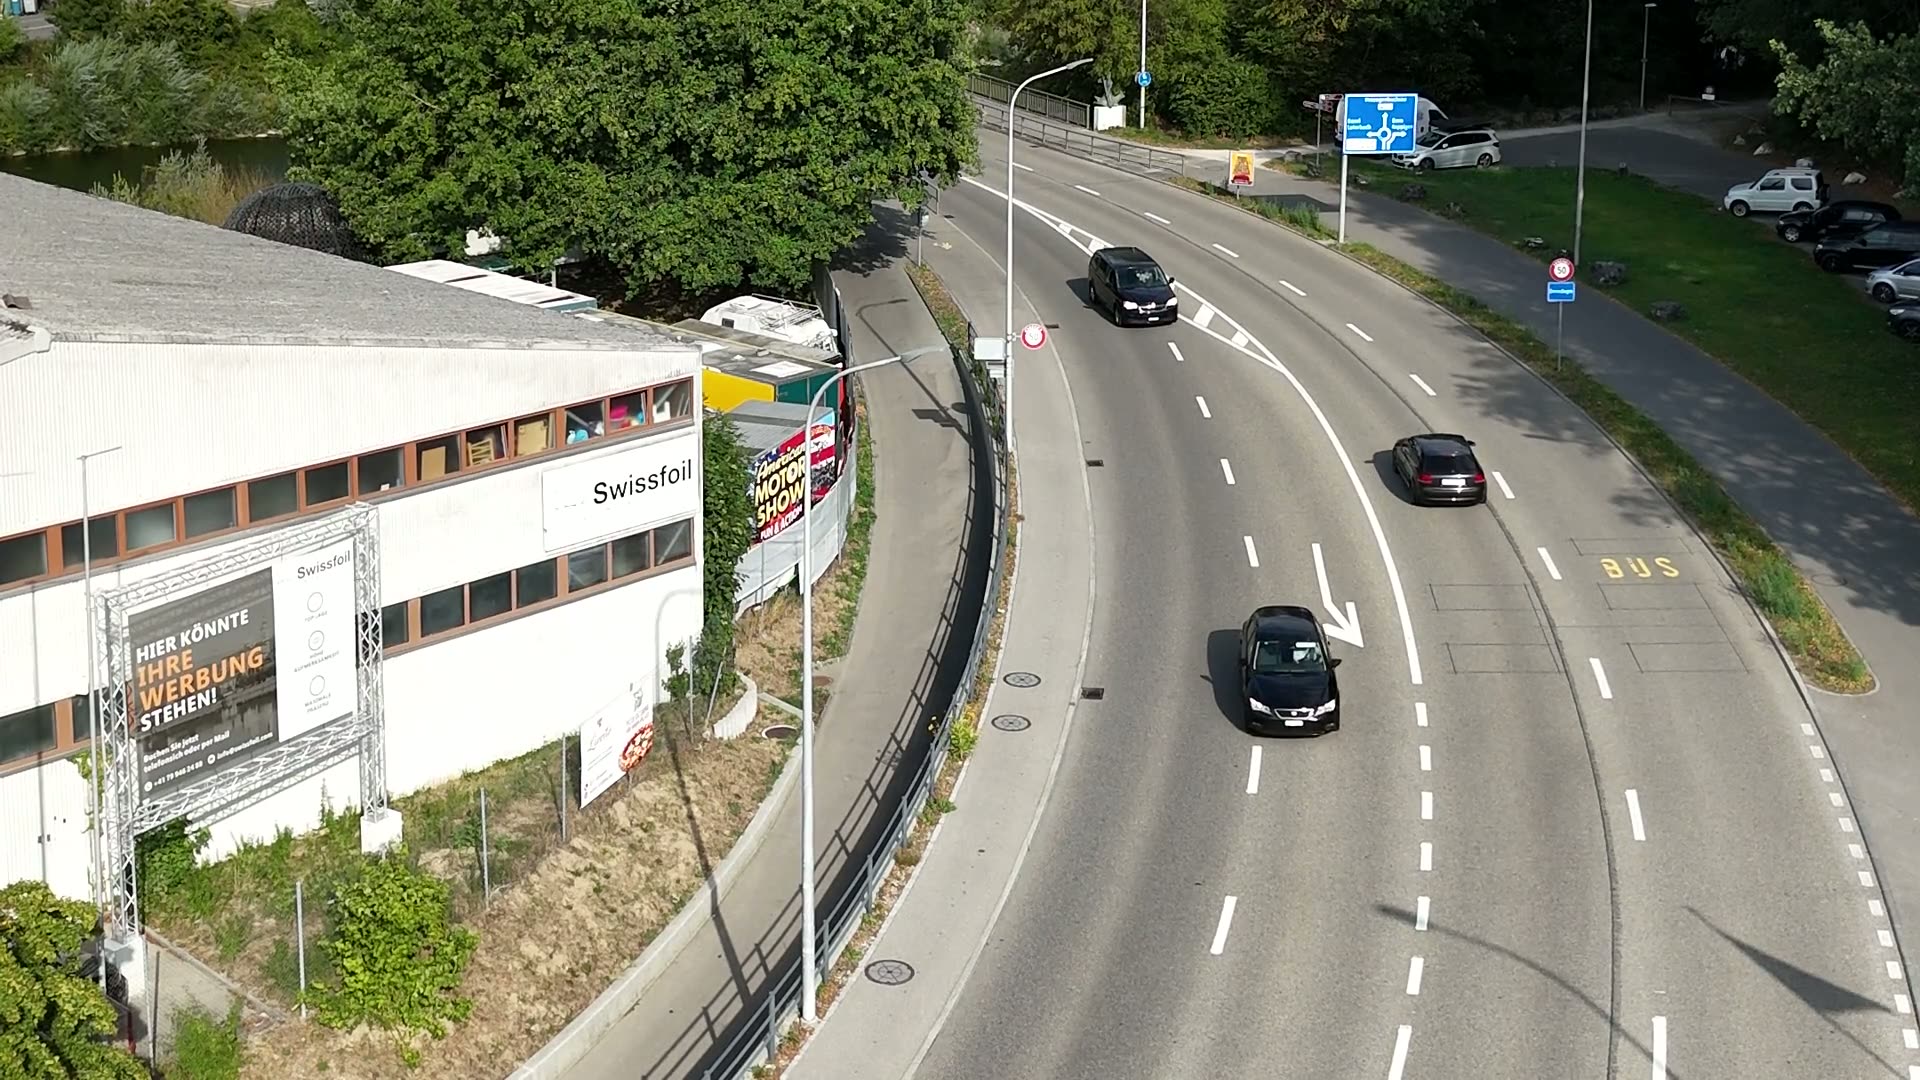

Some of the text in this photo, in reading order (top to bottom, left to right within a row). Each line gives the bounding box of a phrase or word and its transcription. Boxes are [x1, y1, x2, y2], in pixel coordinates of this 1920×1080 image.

[1557, 266, 1567, 275] 50
[593, 458, 692, 505] Swissfoil
[754, 455, 806, 507] MOTOR
[756, 477, 806, 529] SHOW
[297, 550, 351, 579] Swissfoil
[1600, 557, 1679, 578] BUS
[136, 608, 250, 664] HIER KÖNNTE
[137, 649, 194, 688] IHRE
[139, 645, 264, 711] WERBUNG
[140, 687, 217, 732] STEHEN!
[143, 733, 199, 763] Buchen Sie jetzt
[184, 744, 201, 756] oder
[201, 738, 213, 750] per
[214, 729, 230, 743] Mail
